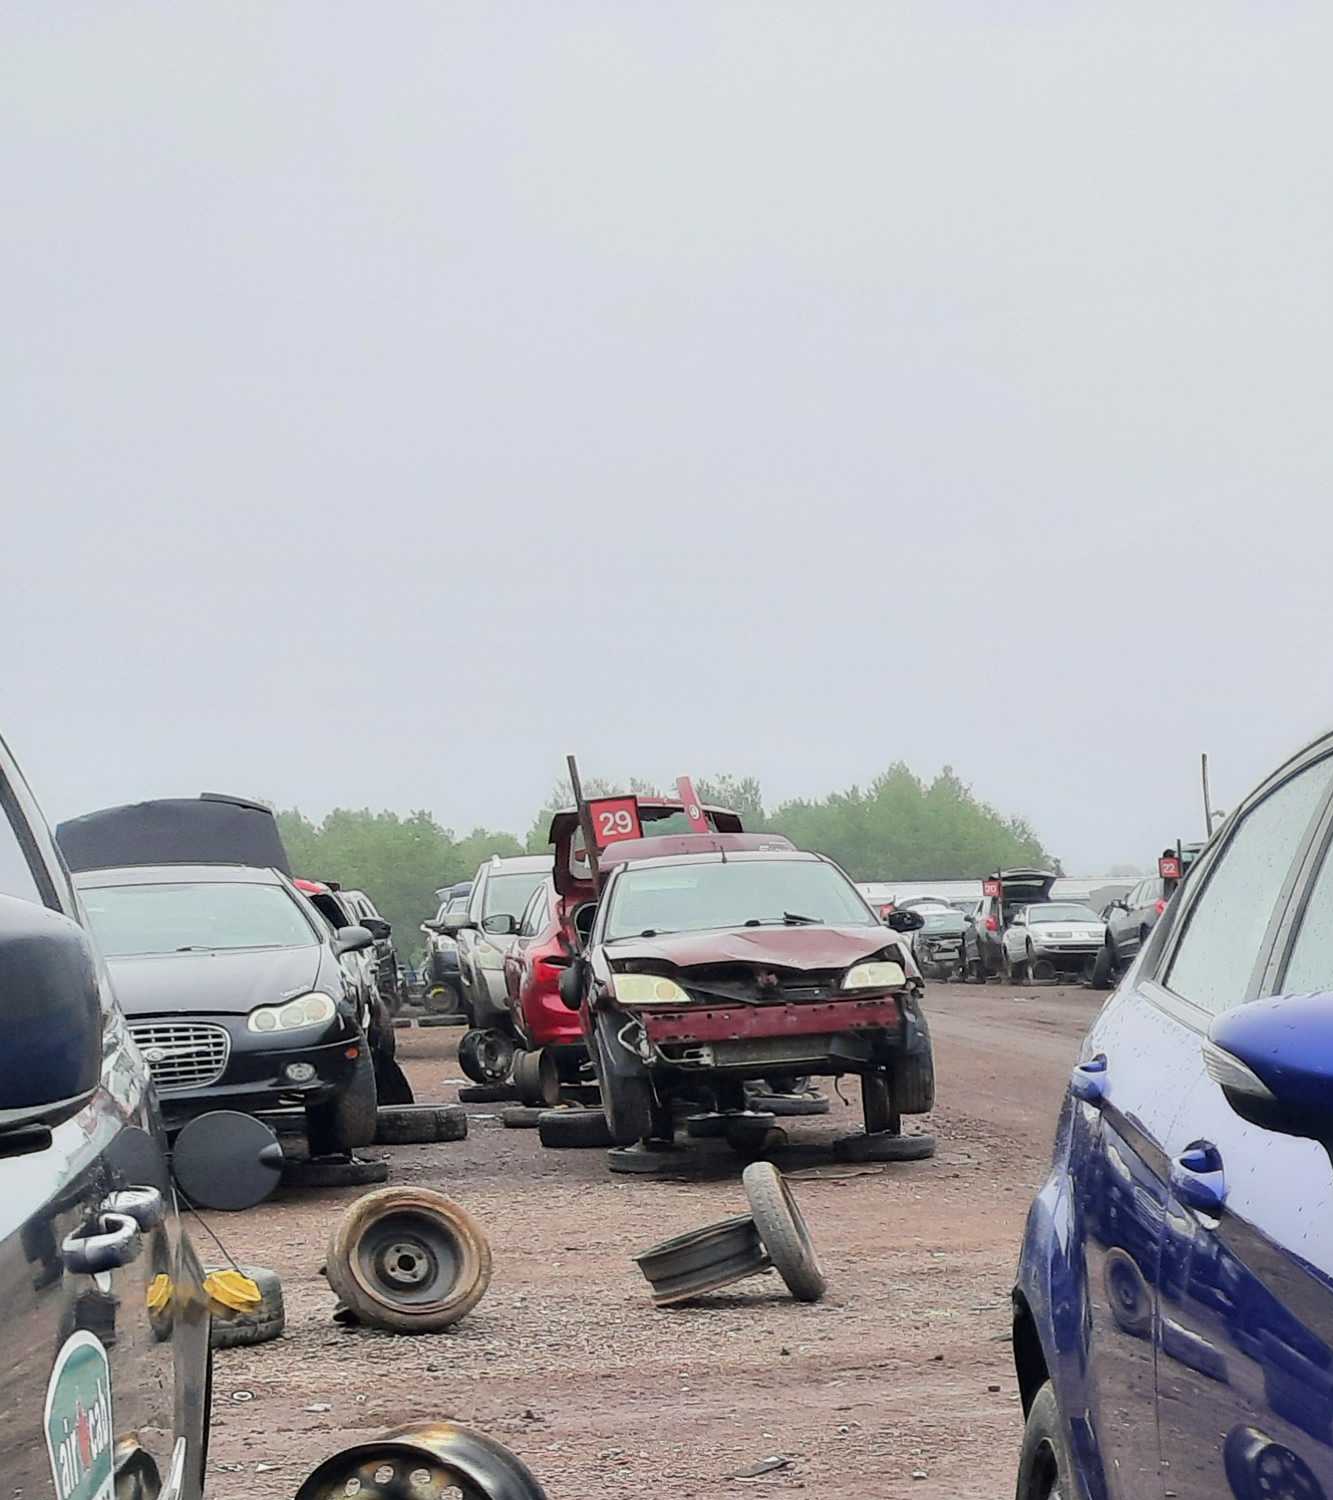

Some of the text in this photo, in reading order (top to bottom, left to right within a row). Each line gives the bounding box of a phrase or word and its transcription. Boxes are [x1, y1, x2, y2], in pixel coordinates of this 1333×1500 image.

[599, 810, 633, 837] 29
[59, 1378, 109, 1500] air cab
